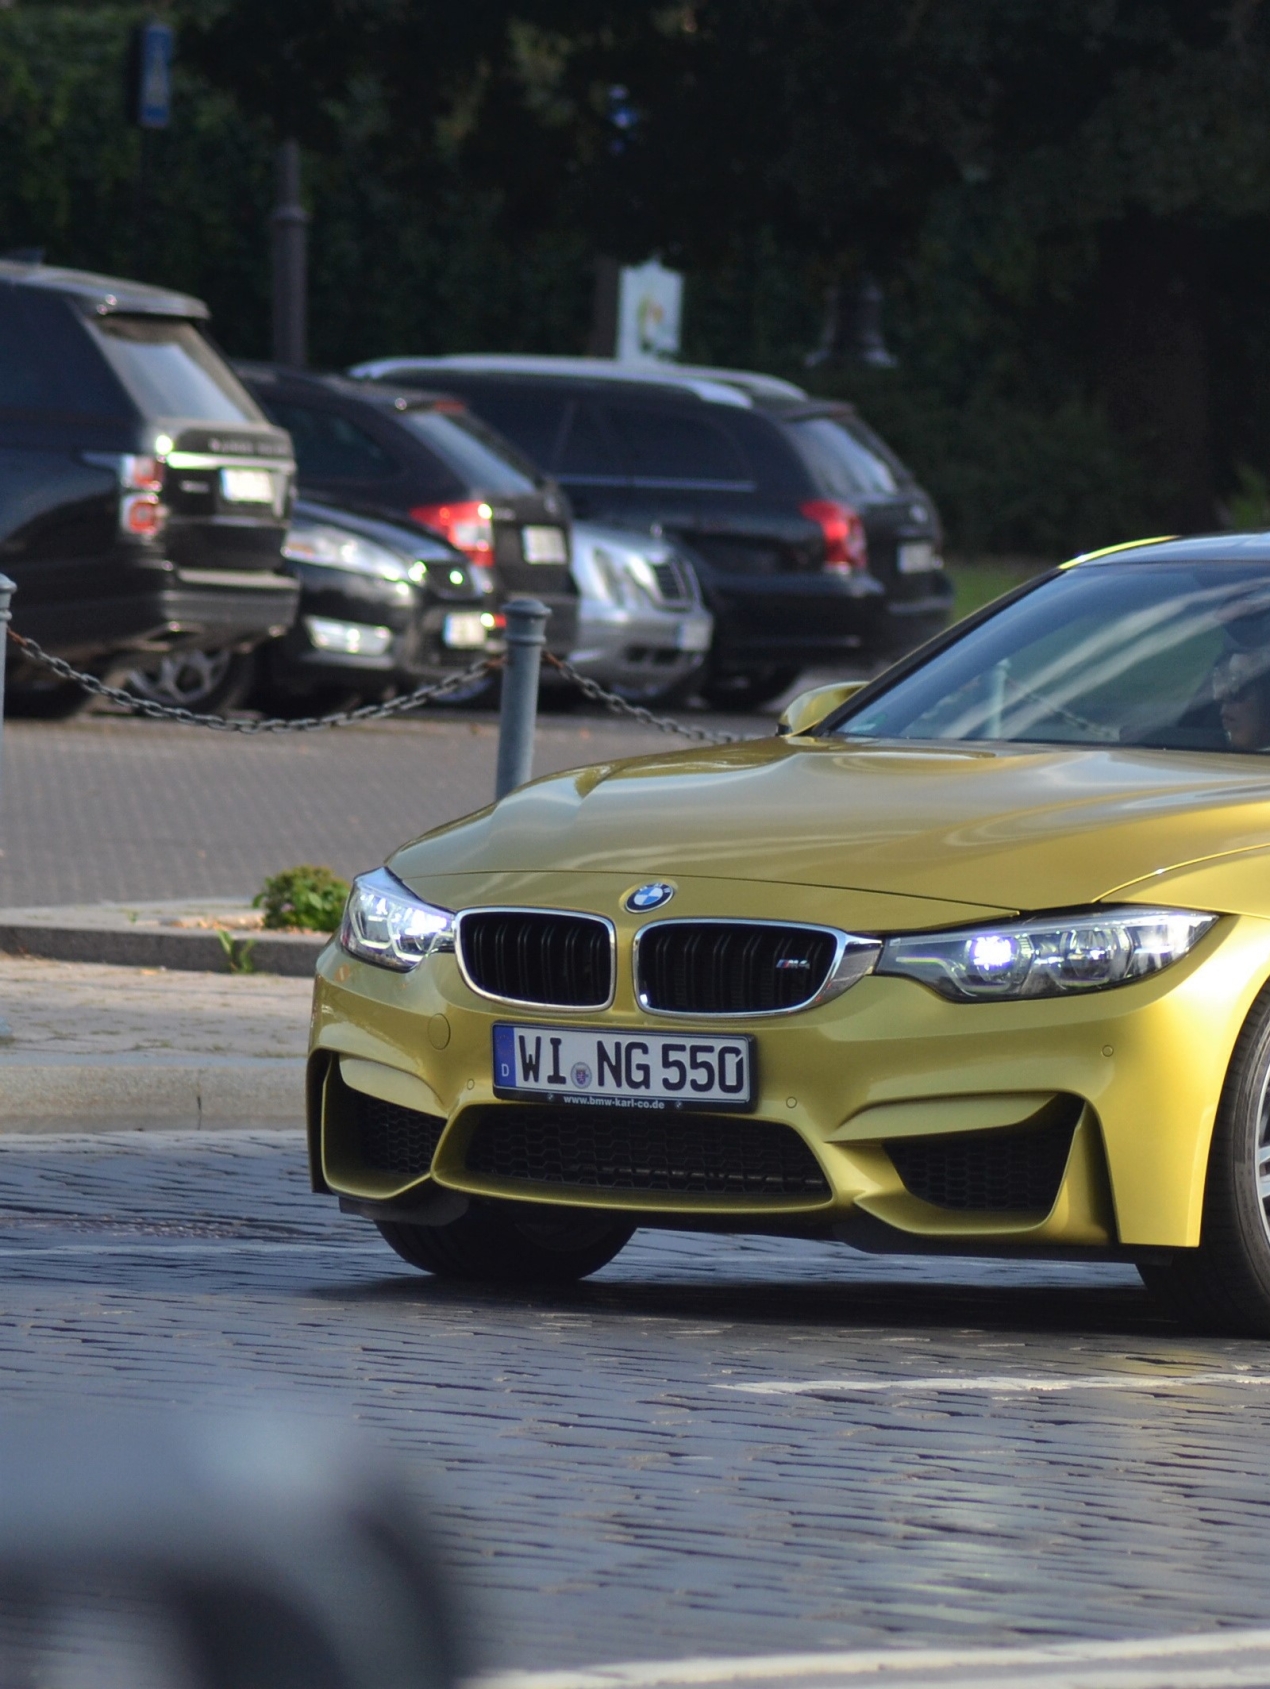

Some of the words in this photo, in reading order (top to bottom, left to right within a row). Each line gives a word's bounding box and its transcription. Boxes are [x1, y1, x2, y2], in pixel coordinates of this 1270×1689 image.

[501, 1063, 510, 1077] D
[518, 1035, 567, 1085] WI
[597, 1040, 651, 1090] NG
[662, 1043, 744, 1094] 550
[563, 1094, 666, 1110] www.bmw-karl-co.de
